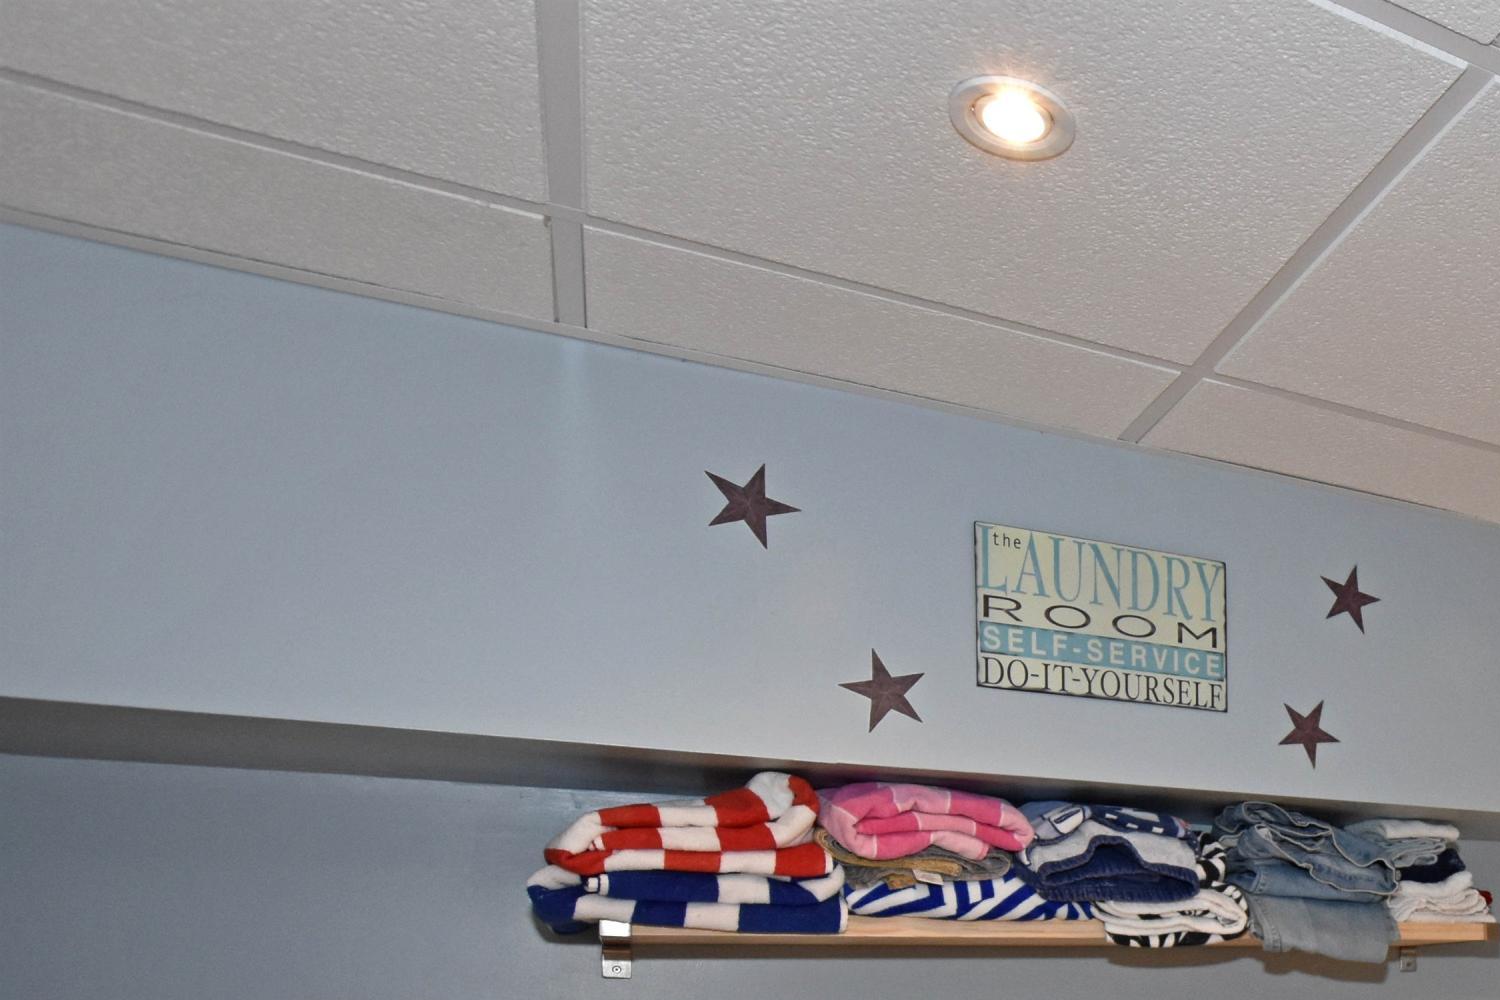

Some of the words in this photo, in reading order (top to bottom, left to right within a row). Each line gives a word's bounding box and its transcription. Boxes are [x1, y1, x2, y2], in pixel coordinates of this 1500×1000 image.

[992, 531, 1021, 549] the
[977, 525, 1223, 623] LAUNDRY
[982, 594, 1218, 649] ROOM
[983, 625, 1222, 678] SELF-SERVICE
[981, 656, 1224, 710] DO-IT-YOURSELF
